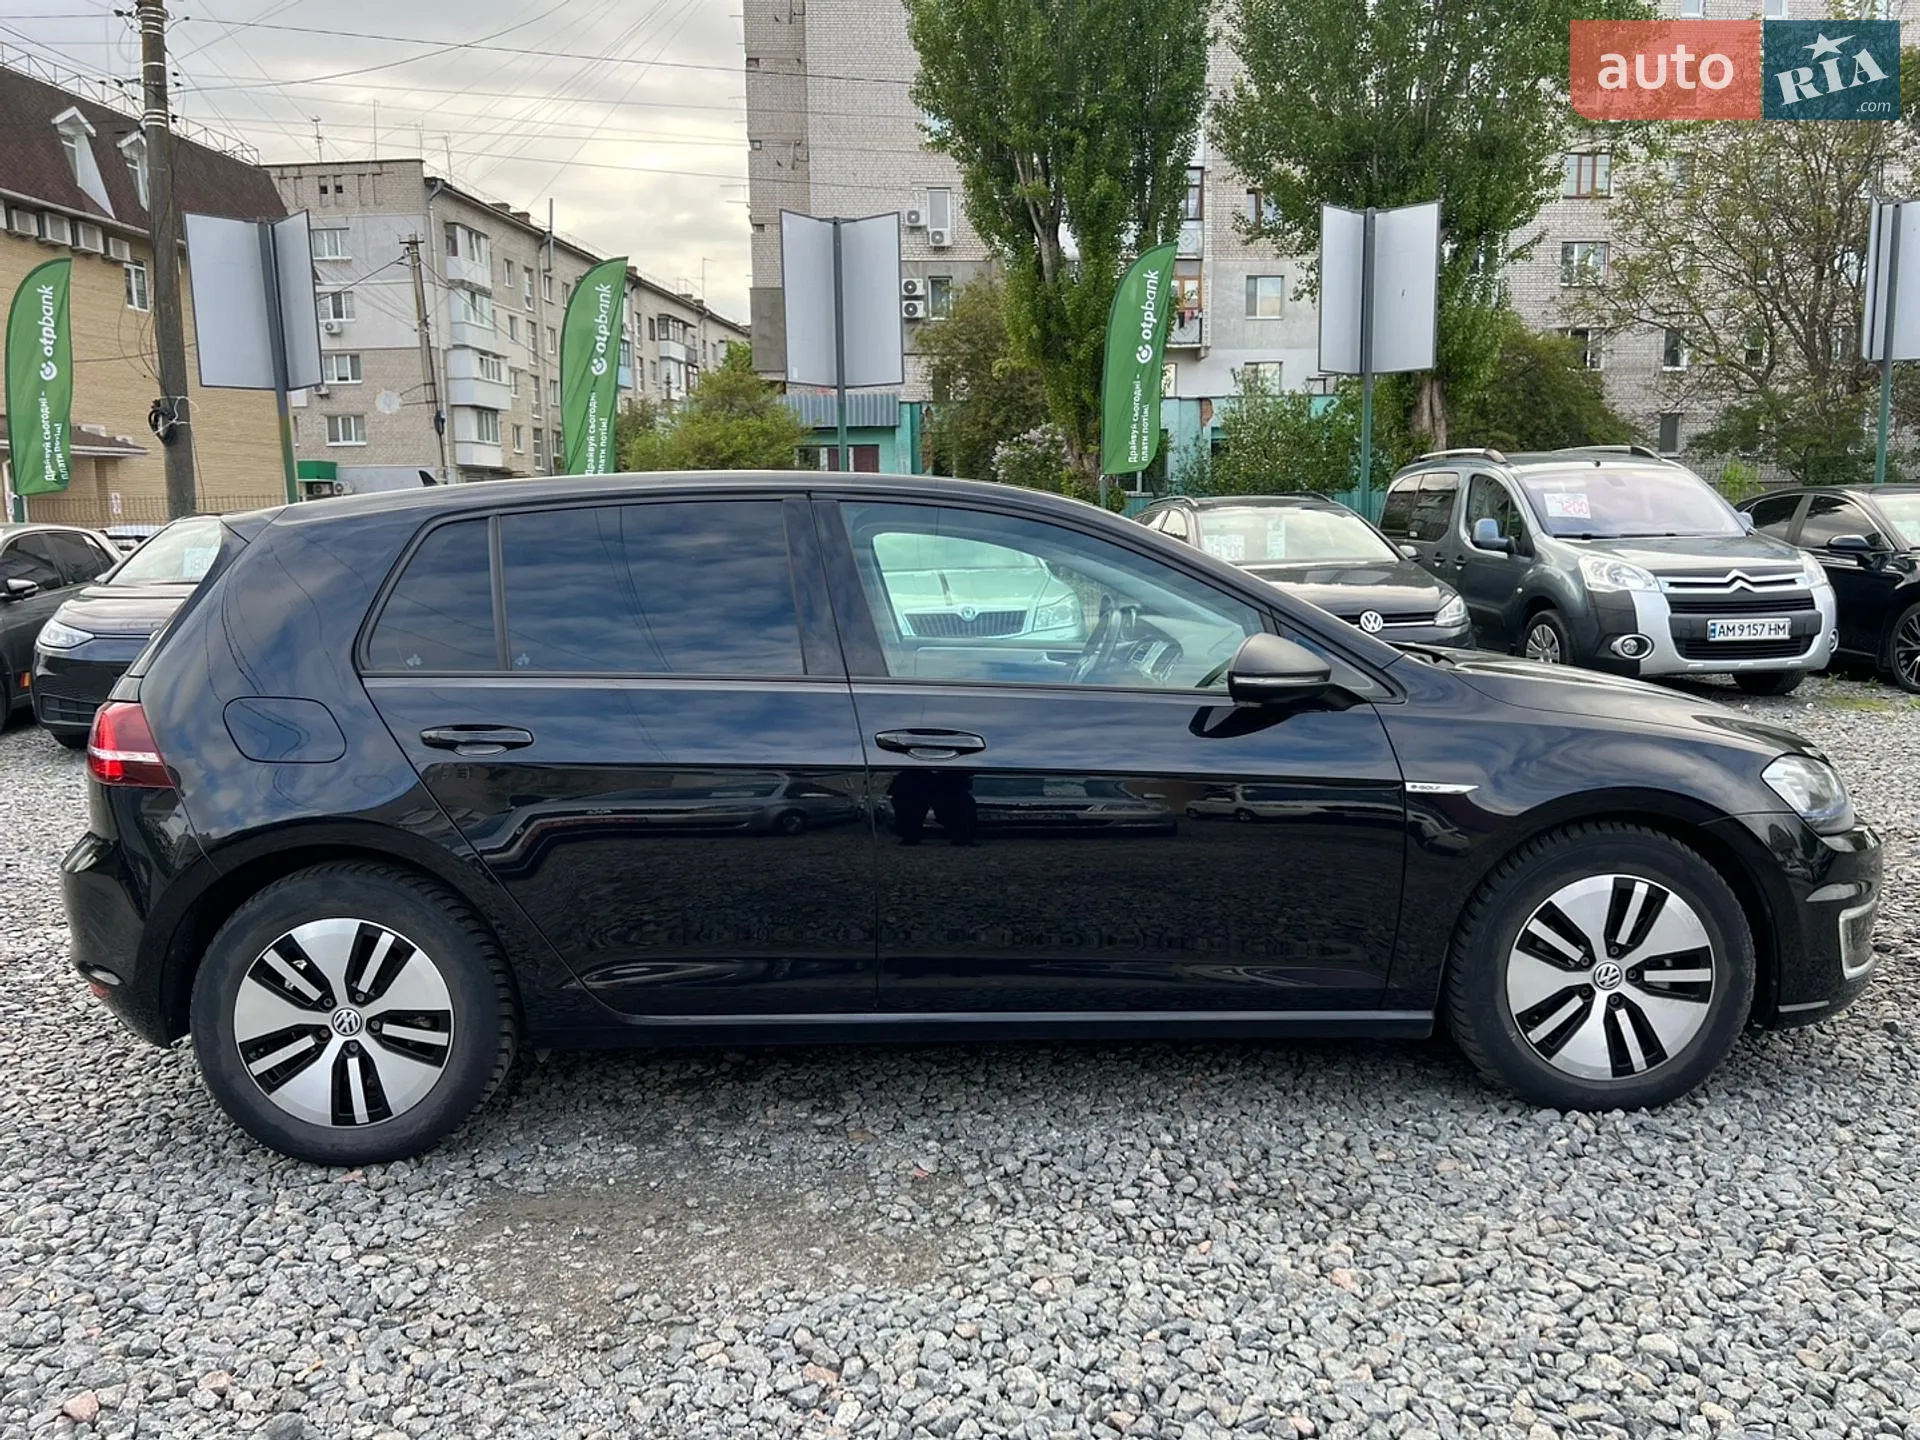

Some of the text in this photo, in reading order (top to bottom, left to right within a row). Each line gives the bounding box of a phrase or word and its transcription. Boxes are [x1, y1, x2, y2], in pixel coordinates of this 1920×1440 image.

[37, 285, 57, 357] otpbank
[593, 283, 612, 353] otpbank
[1142, 268, 1159, 340] otpbank
[1717, 622, 1787, 637] AM 9157 HM
